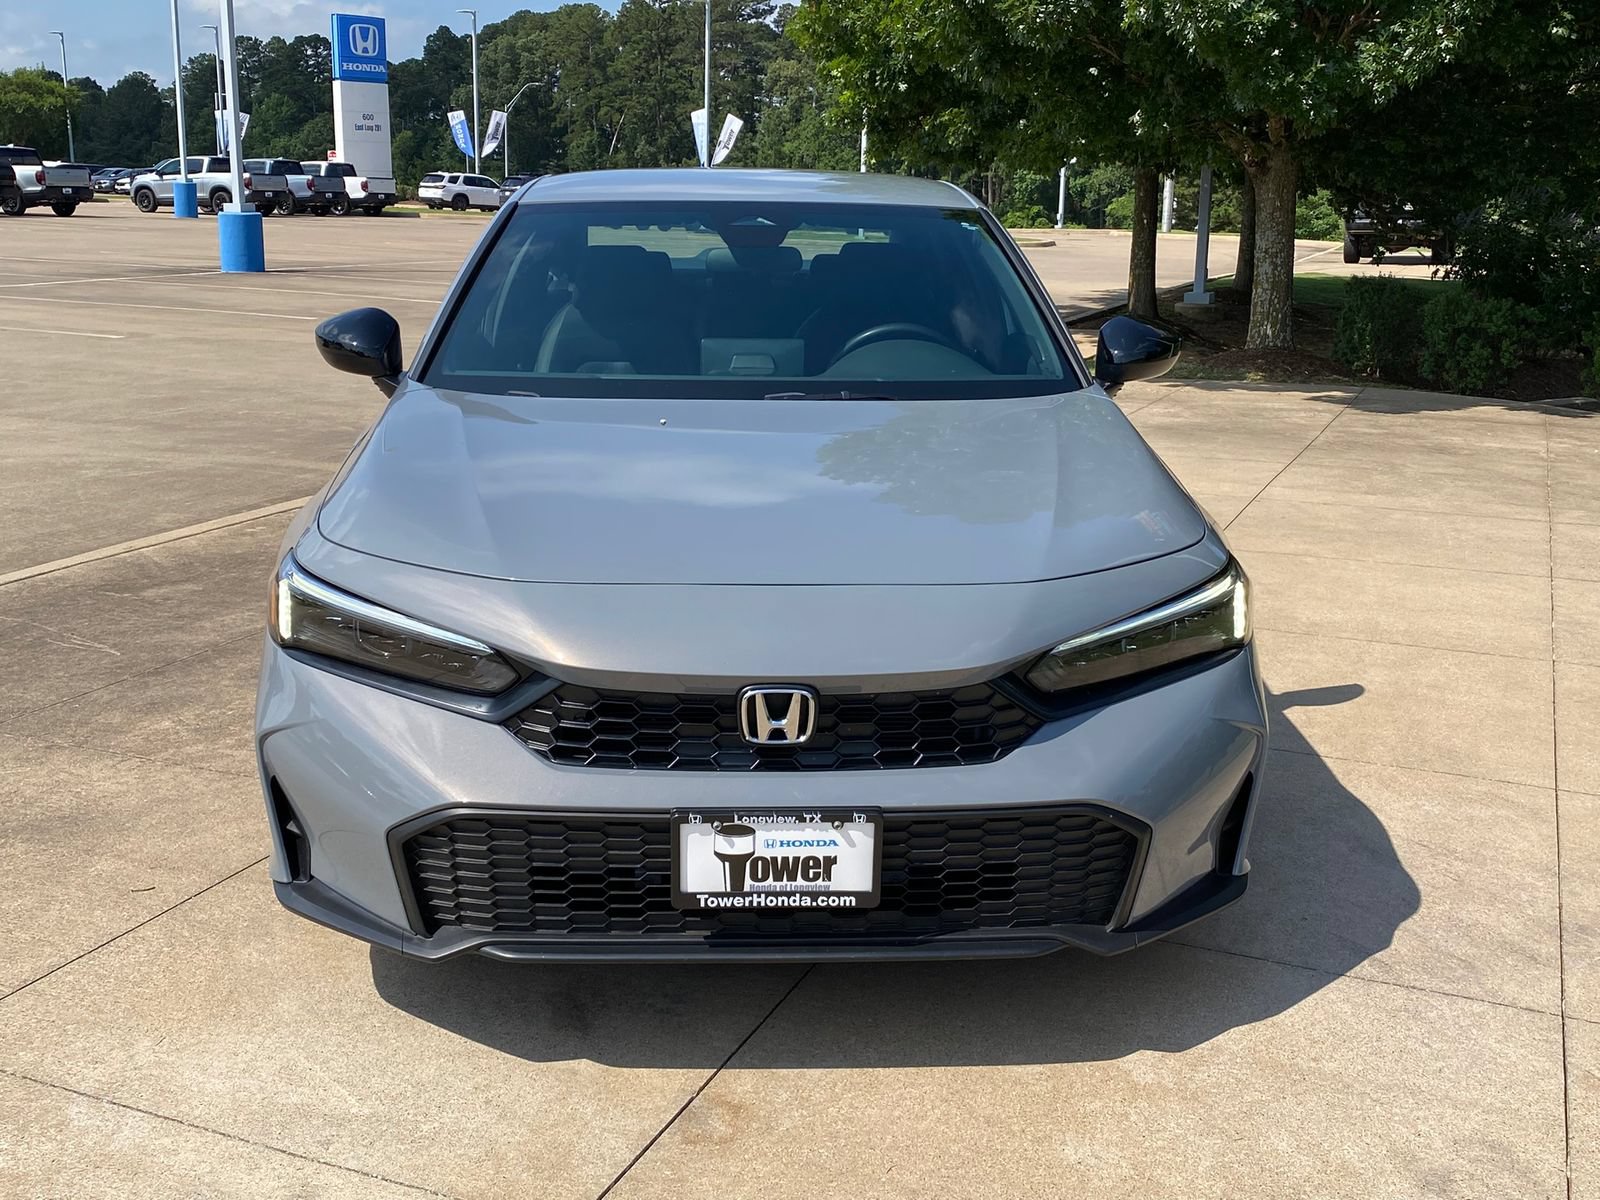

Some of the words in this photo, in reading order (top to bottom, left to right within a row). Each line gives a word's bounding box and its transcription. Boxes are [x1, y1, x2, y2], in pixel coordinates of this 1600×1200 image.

[342, 62, 386, 72] HONDA
[362, 113, 374, 121] 600
[354, 123, 364, 131] East
[734, 813, 799, 824] Longview,
[803, 812, 822, 824] TX
[779, 839, 839, 847] HONDA
[697, 894, 856, 907] TowerHonda.com
